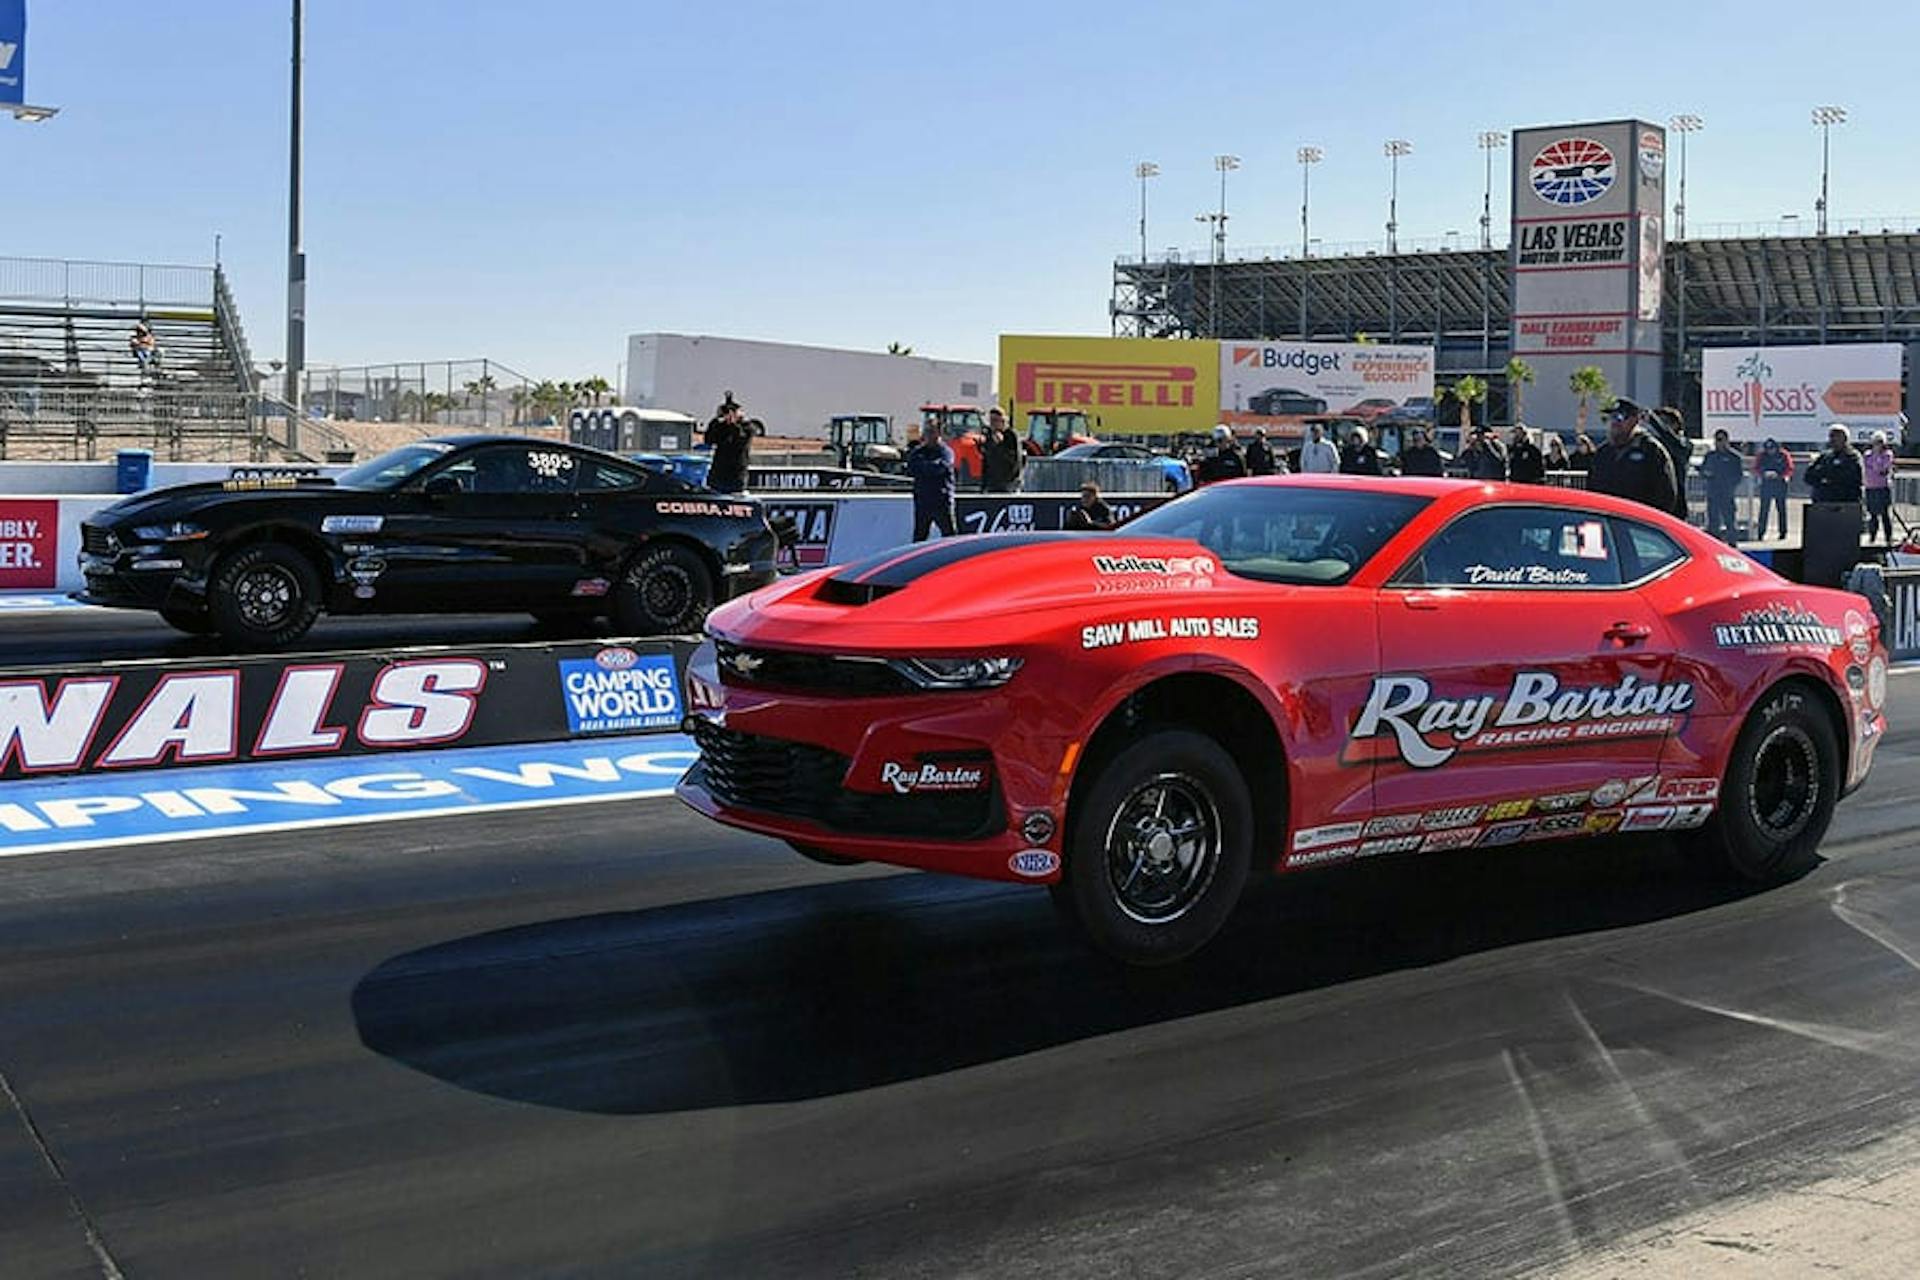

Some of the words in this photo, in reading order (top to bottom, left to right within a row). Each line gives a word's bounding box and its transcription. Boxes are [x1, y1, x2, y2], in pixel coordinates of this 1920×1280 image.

[1521, 226, 1557, 250] LAS
[1564, 222, 1625, 248] VEGAS
[1263, 348, 1341, 375] Budget
[1016, 363, 1195, 407] PIRELLI
[1707, 382, 1816, 413] melissa's
[528, 451, 573, 470] 3805
[656, 502, 721, 516] COBRA
[723, 504, 753, 517] JET
[0, 520, 43, 538] BLY.
[0, 543, 42, 568] ER.
[1096, 558, 1167, 574] Holley
[1464, 564, 1525, 583] David
[1526, 565, 1589, 583] Barton
[1082, 623, 1124, 649] SAW
[1128, 620, 1168, 642] MILL
[1170, 618, 1210, 637] AUTO
[1213, 617, 1259, 638] SALES
[1716, 624, 1783, 646] RETAIL
[567, 668, 671, 694] CAMPING
[0, 657, 488, 773] NALS
[570, 689, 675, 718] WORLD
[1351, 676, 1495, 768] Ray
[1496, 672, 1693, 727] Barton
[1477, 723, 1571, 746] RACING
[1576, 717, 1676, 736] ENGINES
[881, 762, 918, 793] Ray
[919, 764, 981, 784] Barton
